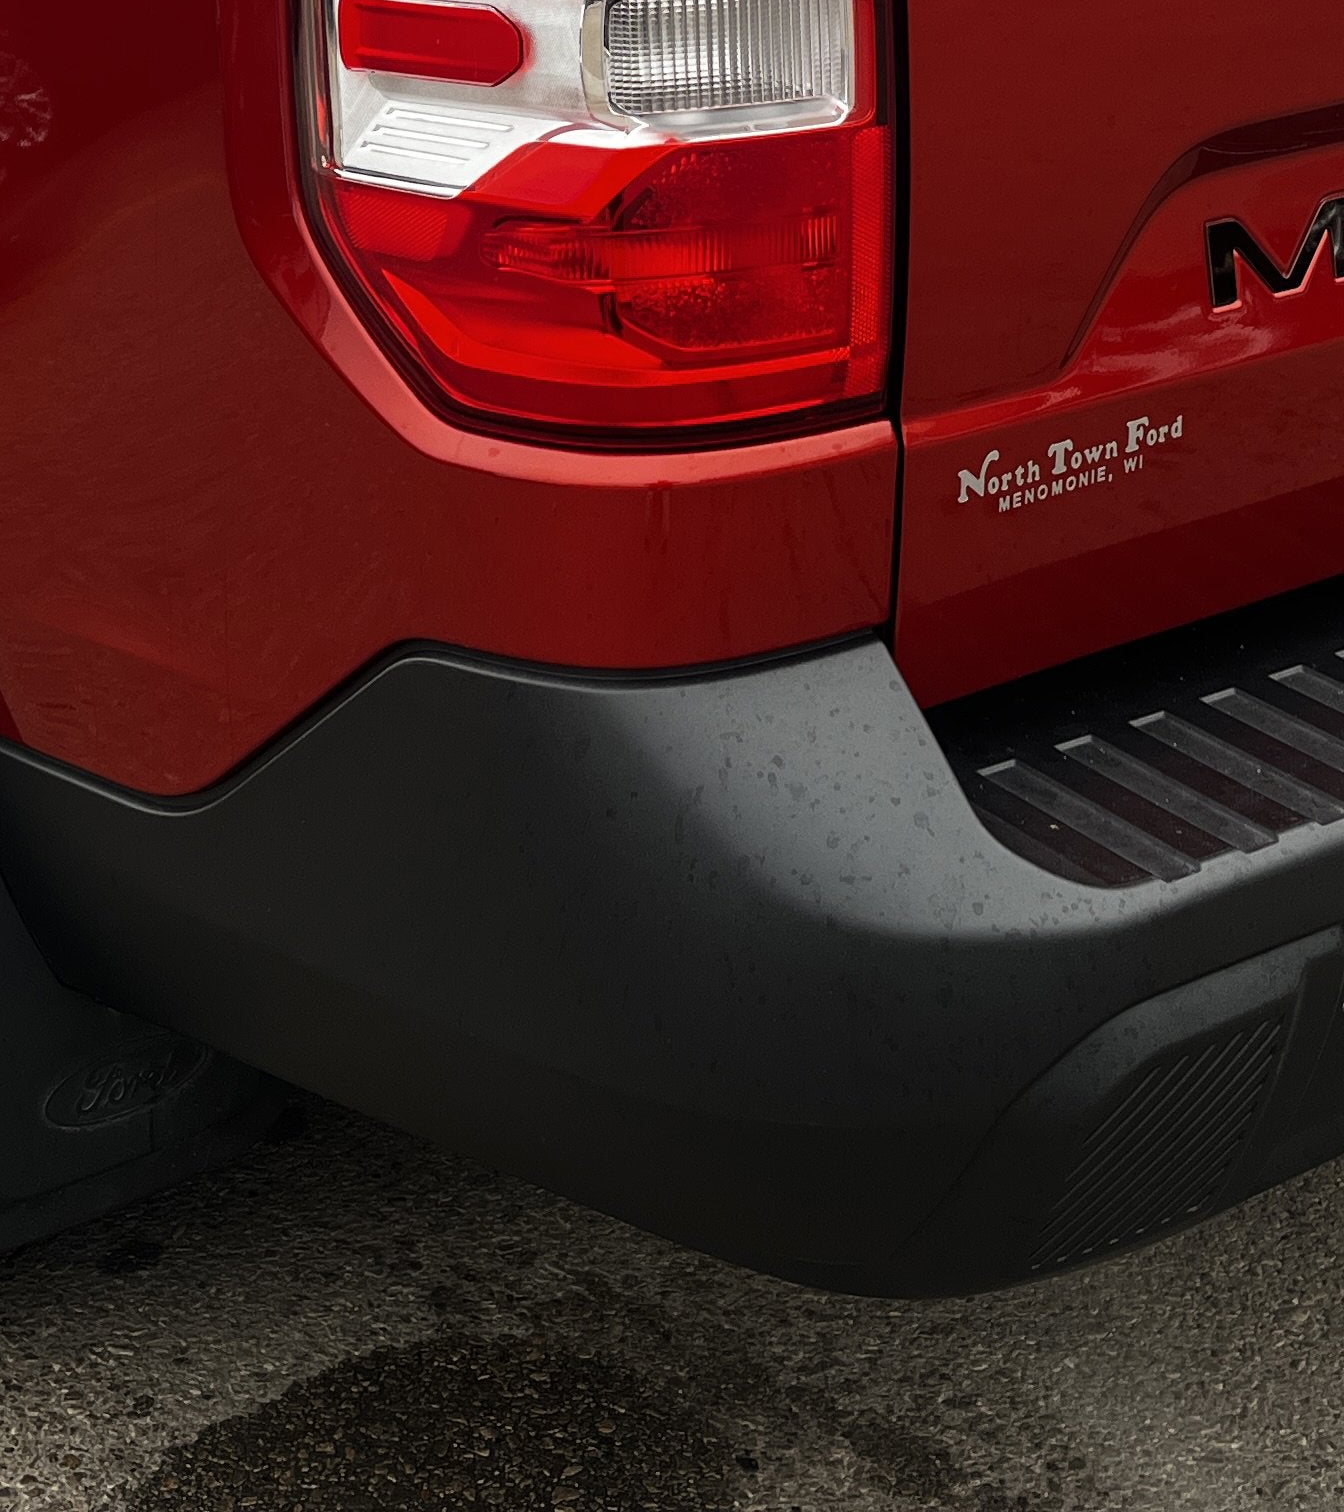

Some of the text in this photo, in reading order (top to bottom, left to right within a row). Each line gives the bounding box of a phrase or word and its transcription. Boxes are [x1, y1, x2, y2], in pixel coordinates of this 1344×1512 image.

[957, 414, 1184, 504] North Town Ford
[998, 454, 1144, 513] MENOMONIE, WI
